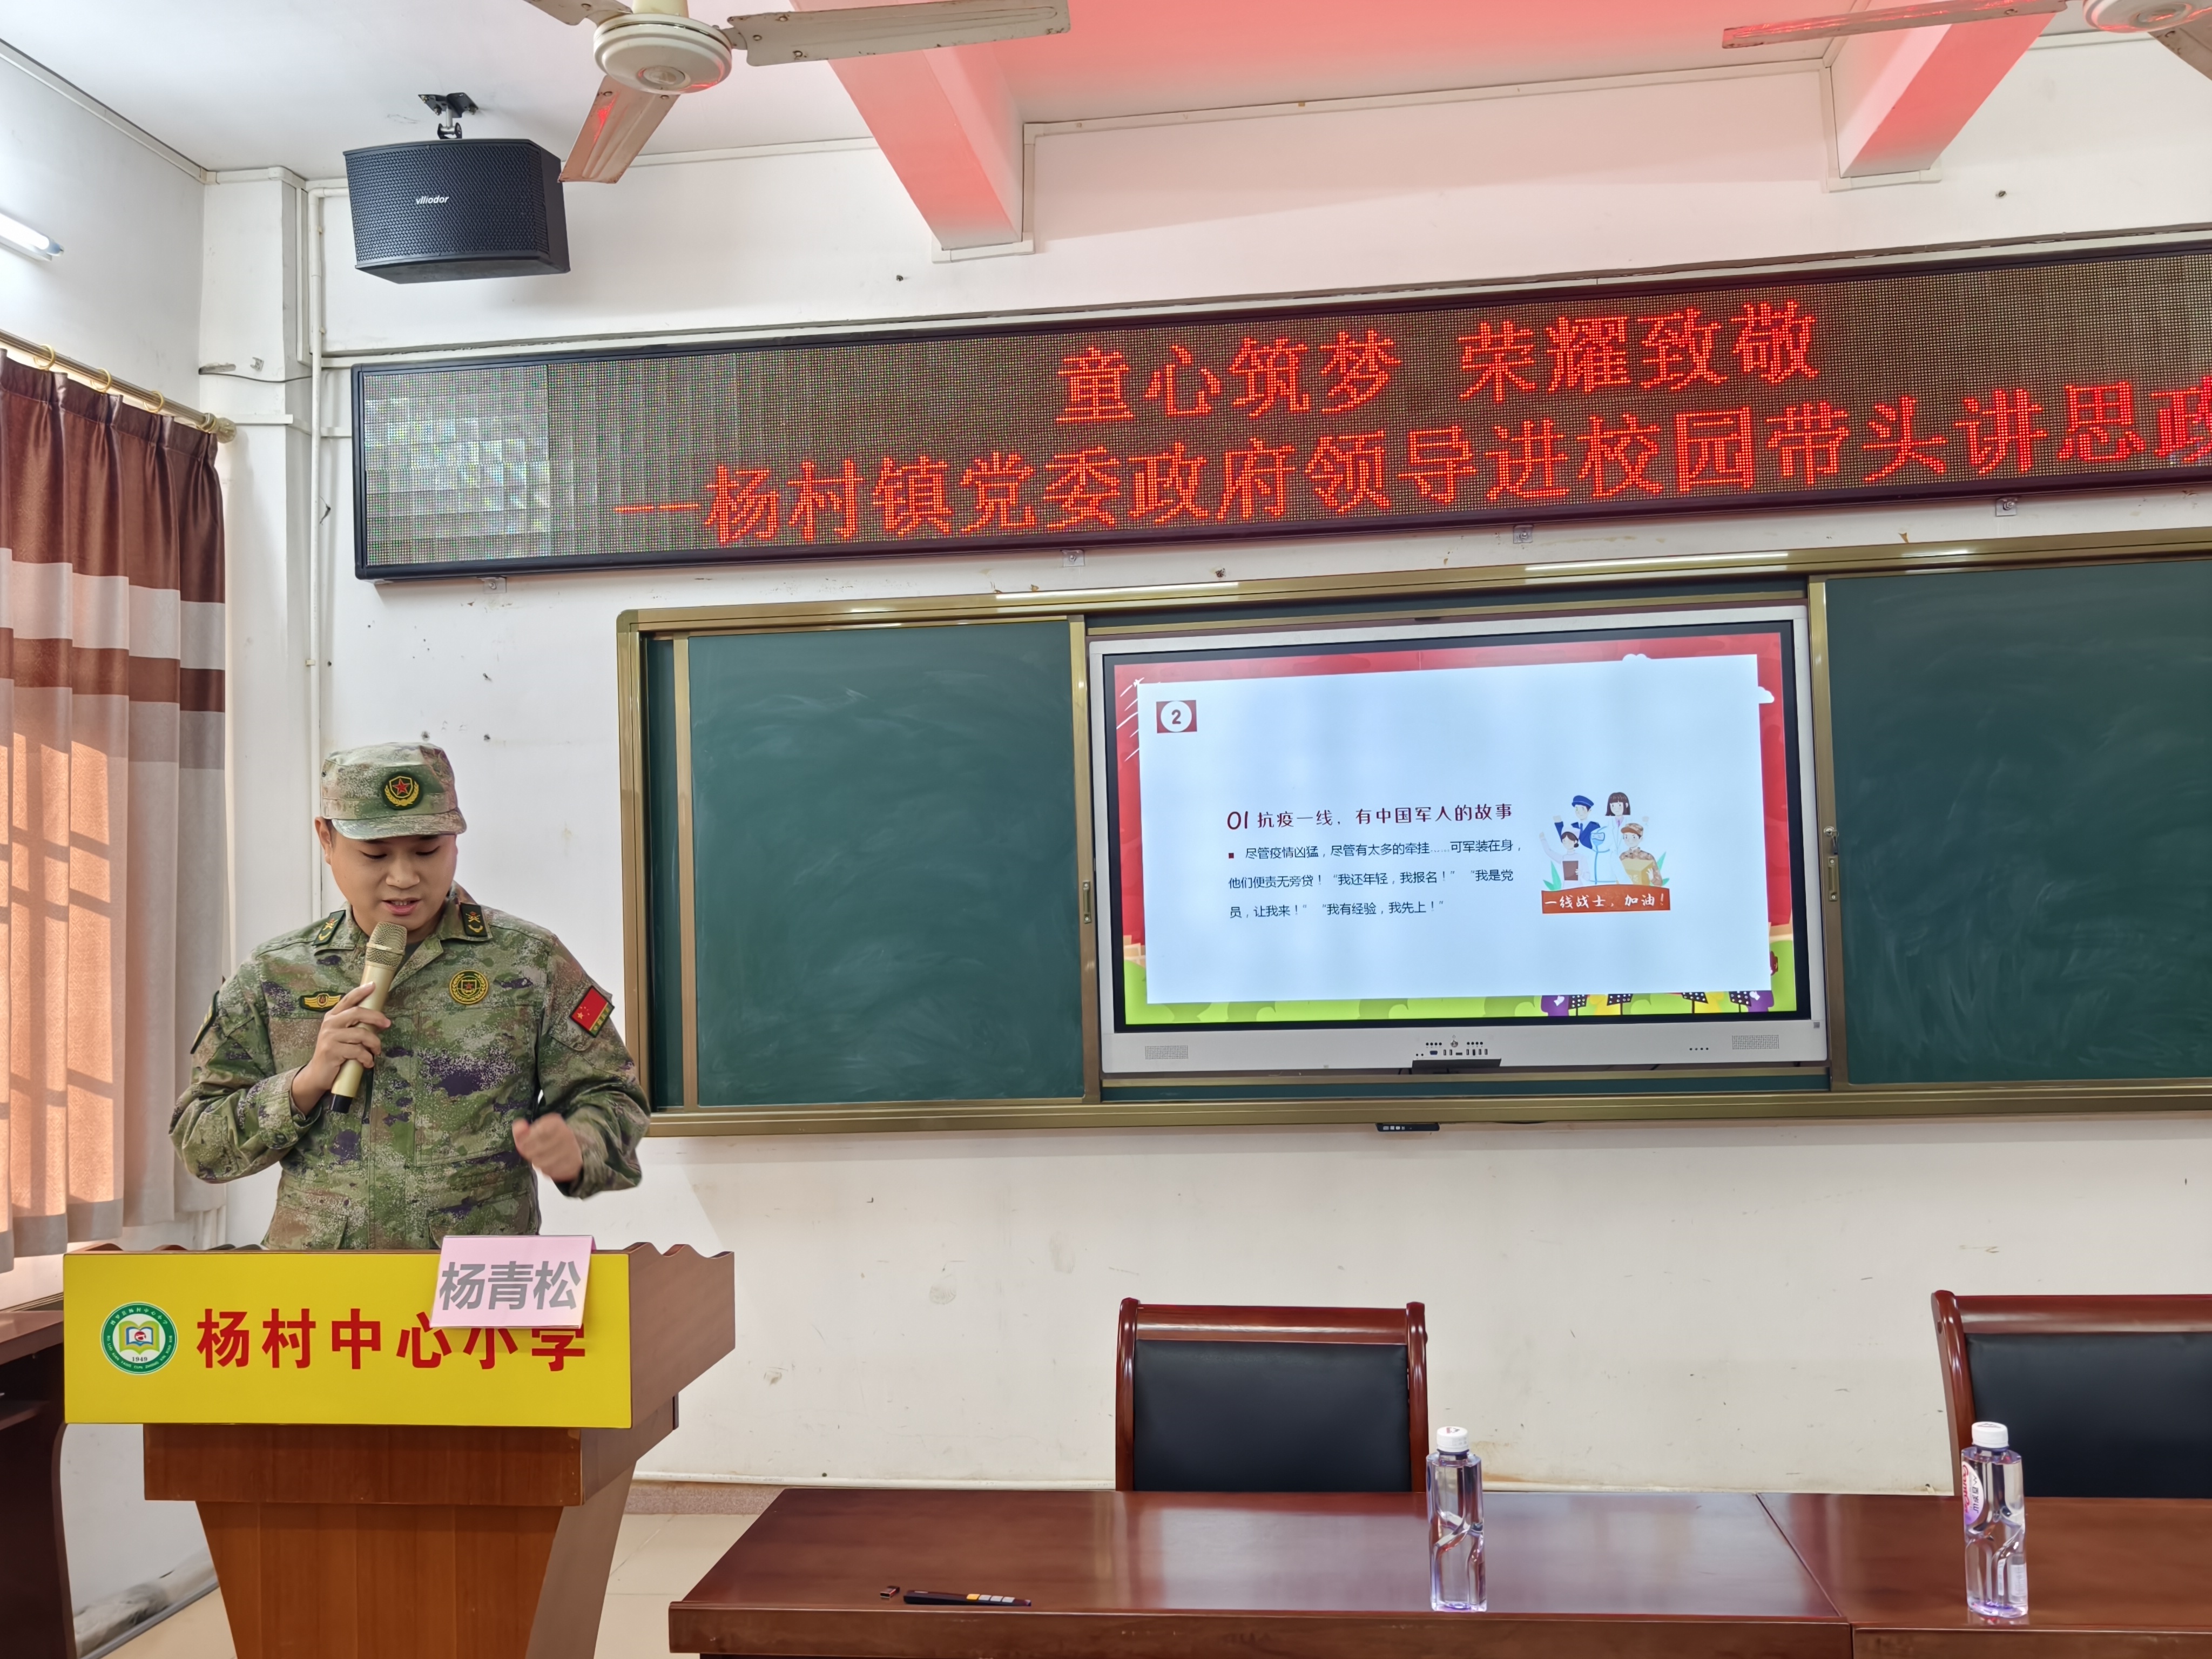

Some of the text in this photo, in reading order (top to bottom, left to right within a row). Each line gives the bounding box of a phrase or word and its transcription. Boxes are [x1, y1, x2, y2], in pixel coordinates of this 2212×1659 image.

[1056, 300, 1819, 422] 童心筑梦 荣耀致敬
[1171, 709, 1181, 724] 2
[439, 1261, 581, 1311] 杨青松
[197, 1308, 585, 1372] 杨村中心小学
